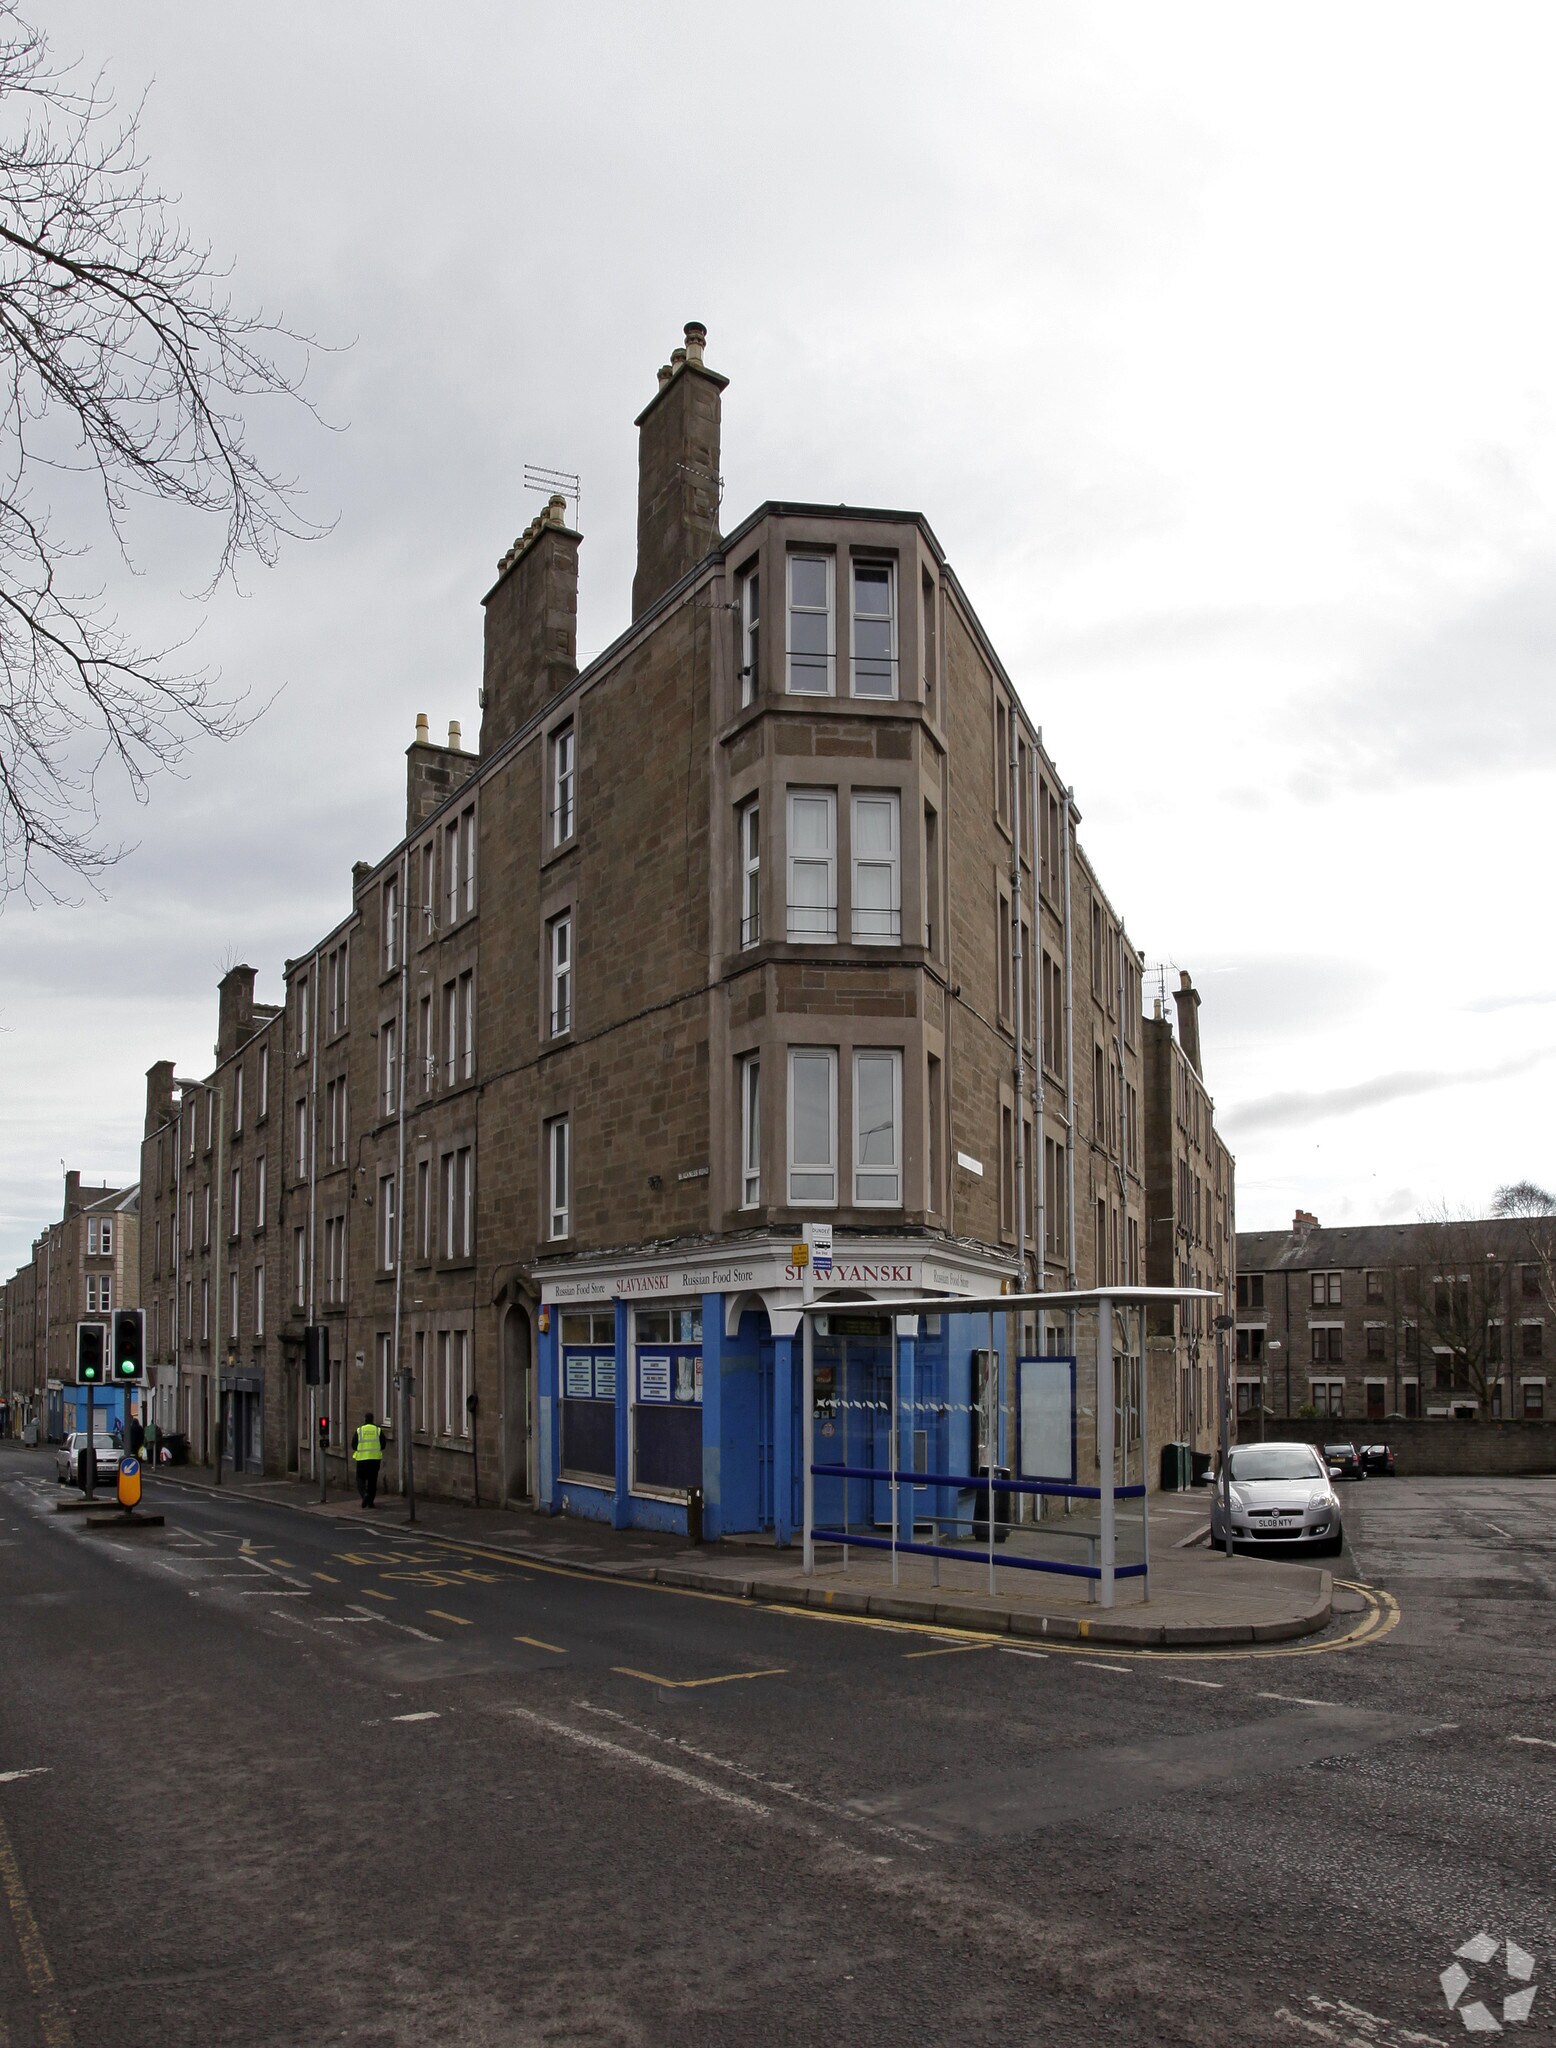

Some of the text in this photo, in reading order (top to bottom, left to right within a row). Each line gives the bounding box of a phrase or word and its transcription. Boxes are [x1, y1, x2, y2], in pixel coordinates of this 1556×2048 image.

[616, 1275, 669, 1293] SLAVYANSKI
[682, 1268, 753, 1287] Russian Food Store
[555, 1283, 605, 1297] Russian Food Store
[1278, 1518, 1293, 1526] NTY
